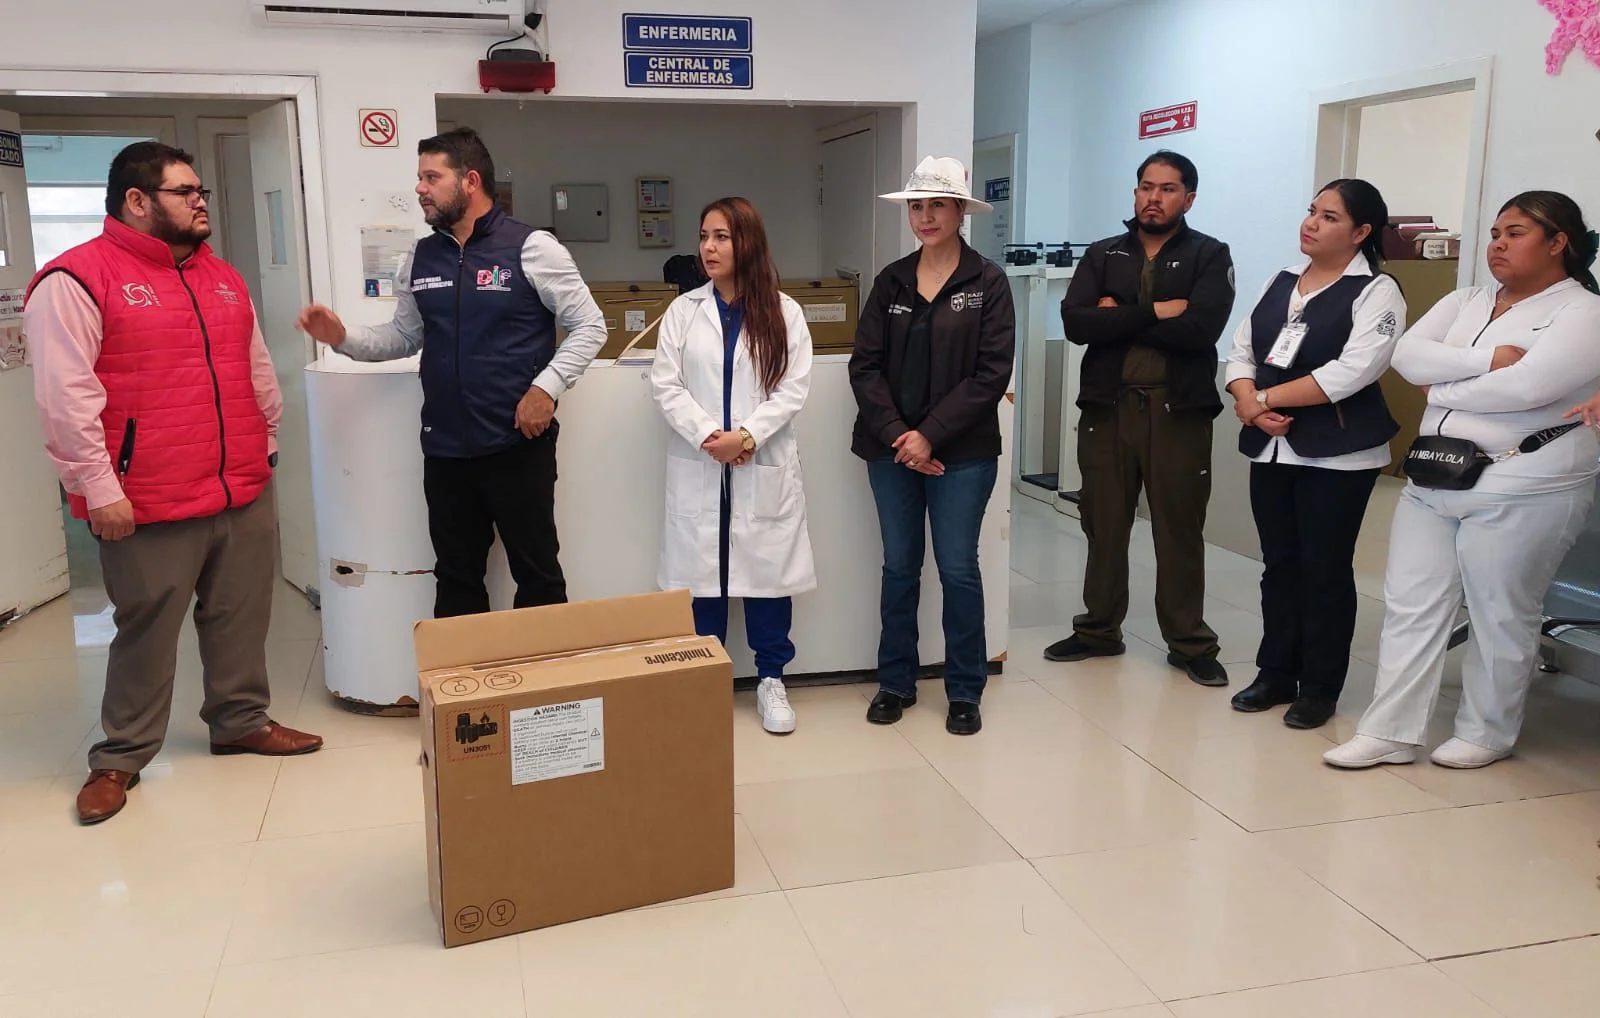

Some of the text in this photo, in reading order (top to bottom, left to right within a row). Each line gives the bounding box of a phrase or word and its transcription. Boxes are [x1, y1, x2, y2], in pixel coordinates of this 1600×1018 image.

[639, 25, 737, 41] ENFERMERIA
[648, 57, 730, 71] CENTRAL DE
[646, 70, 733, 84] ENFERMERAS
[644, 648, 716, 665] ThinkCentre
[541, 702, 581, 714] WARNING
